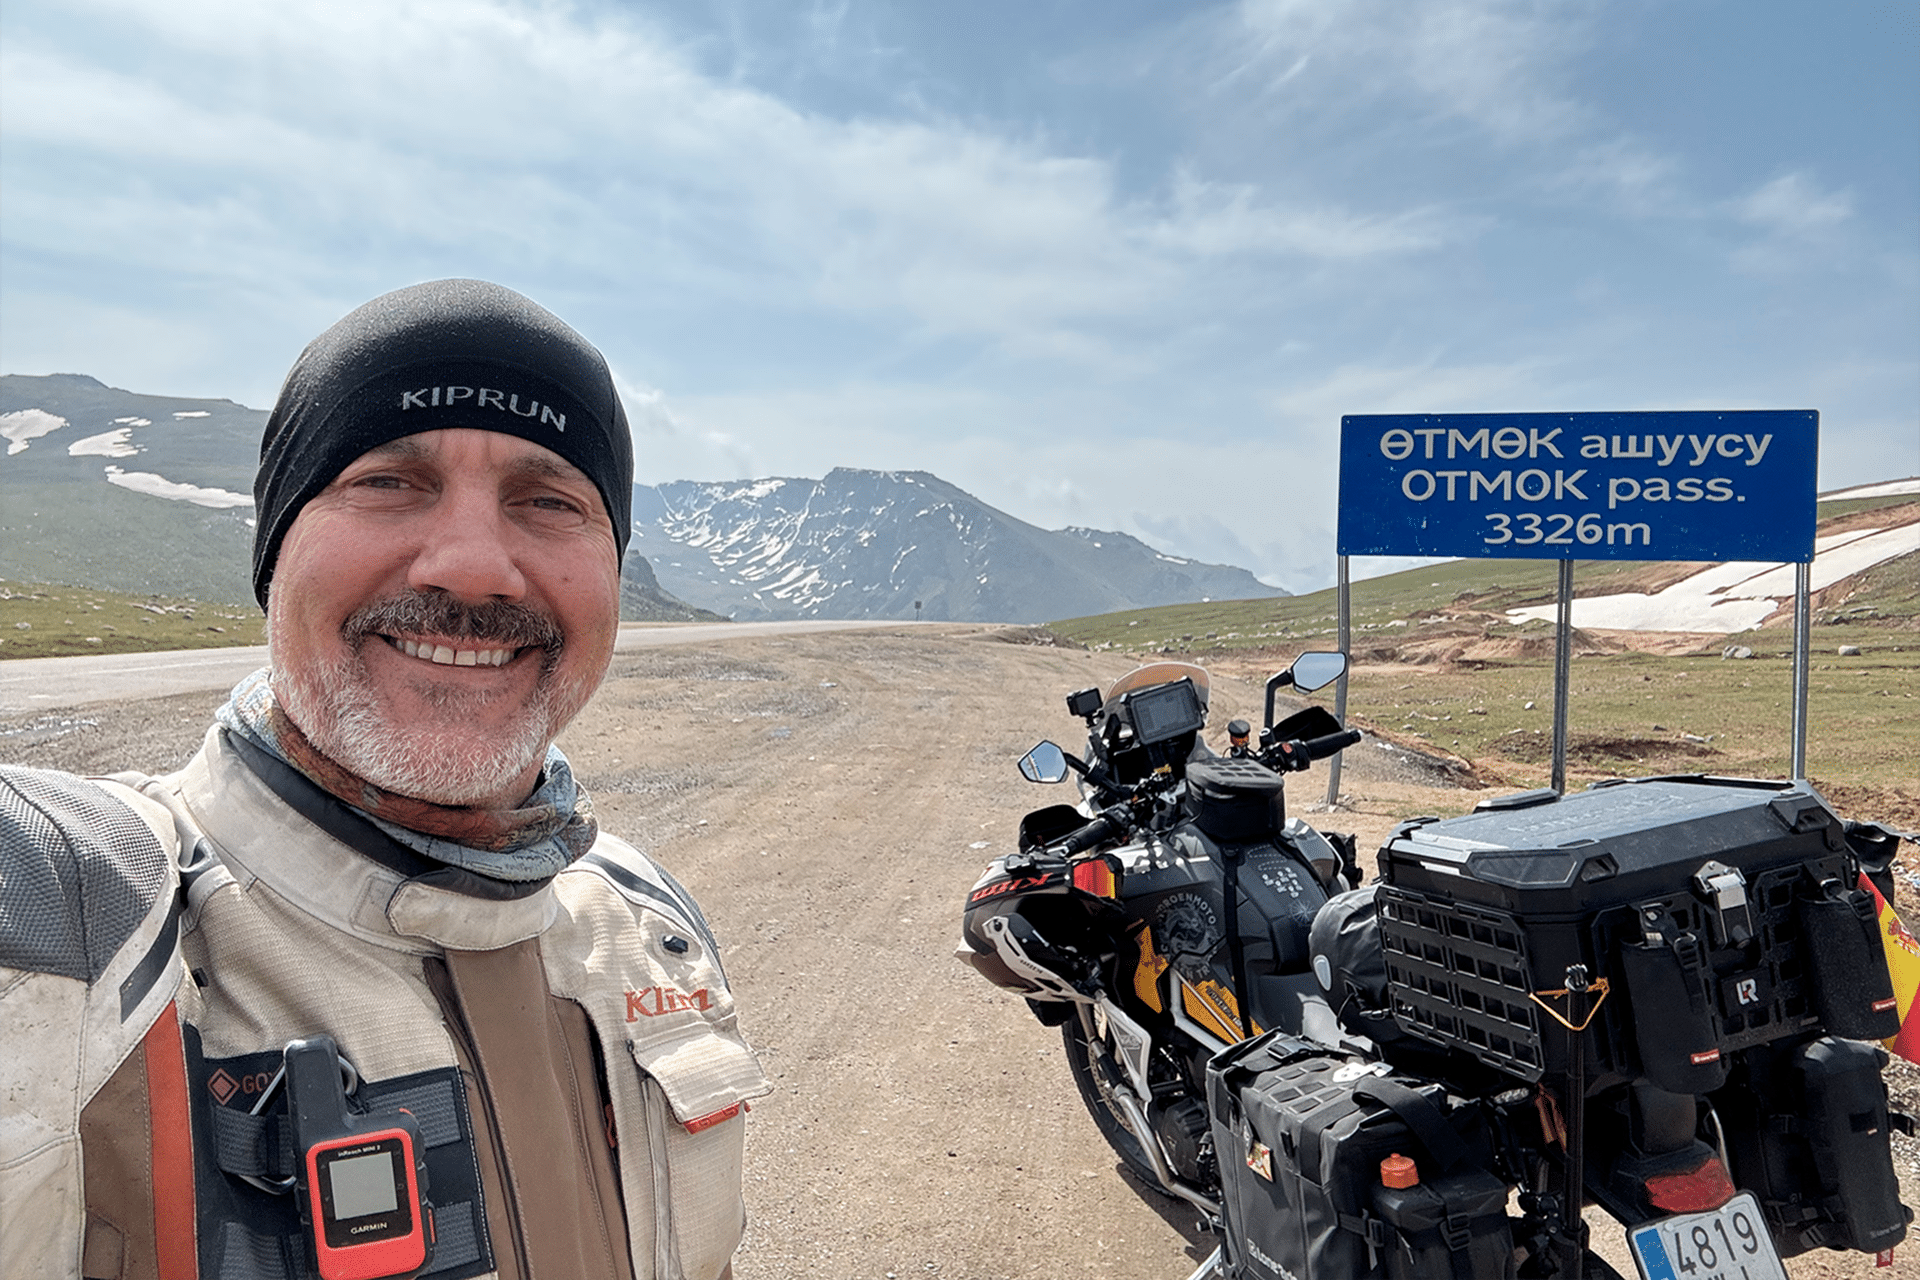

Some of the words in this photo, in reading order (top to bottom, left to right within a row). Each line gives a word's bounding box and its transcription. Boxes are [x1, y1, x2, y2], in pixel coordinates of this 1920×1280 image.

[402, 386, 566, 433] KIPRUN
[1380, 427, 1564, 460] ӨТМӨК
[1580, 433, 1772, 466] ашуусу
[1402, 469, 1588, 502] OTMOK
[1608, 475, 1746, 509] pass.
[1484, 513, 1651, 546] 3326m
[624, 986, 714, 1023] Klim
[350, 1222, 388, 1235] GARMIN
[1675, 1212, 1758, 1275] 4819
